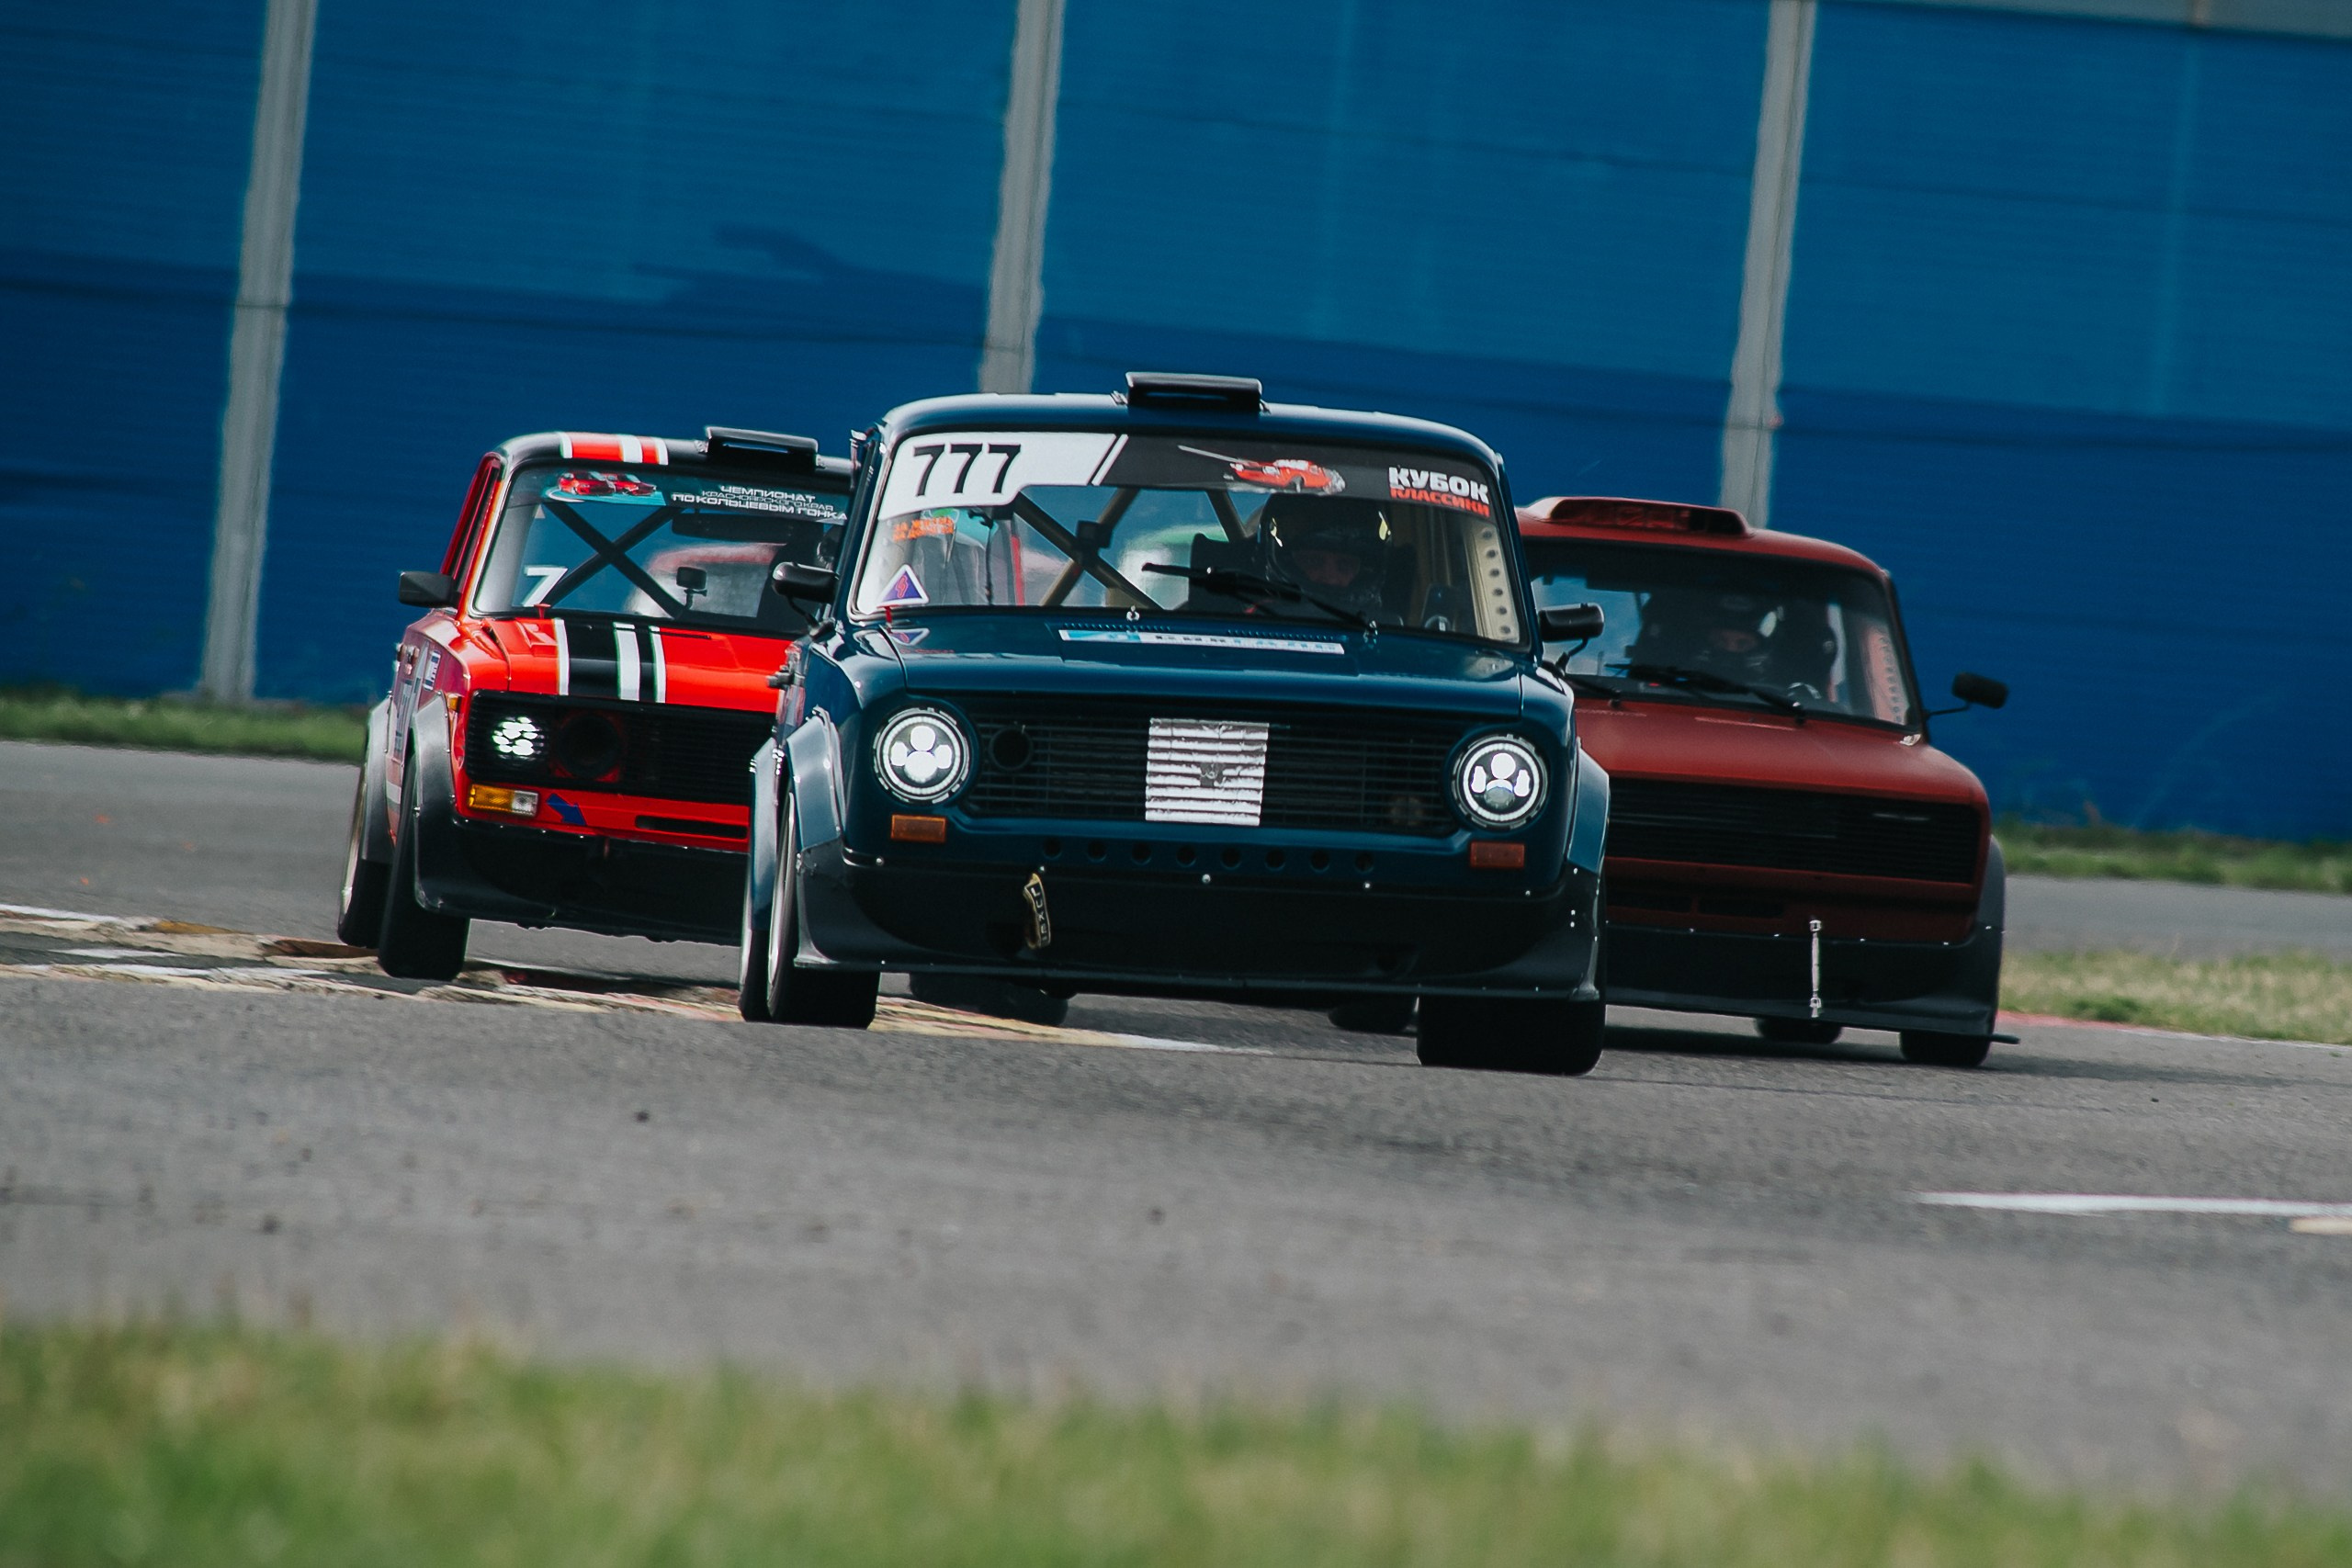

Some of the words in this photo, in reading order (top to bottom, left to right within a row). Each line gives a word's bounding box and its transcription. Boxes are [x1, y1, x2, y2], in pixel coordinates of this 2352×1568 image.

[913, 443, 1021, 497] 777
[1388, 467, 1489, 504] КУБОК
[672, 493, 695, 502] ПО
[695, 496, 794, 514] КОЛЬЦЕВЫМ
[797, 507, 848, 521] ГОНКА
[720, 485, 816, 504] ЧЕМПИОНАТ
[523, 565, 569, 607] 7
